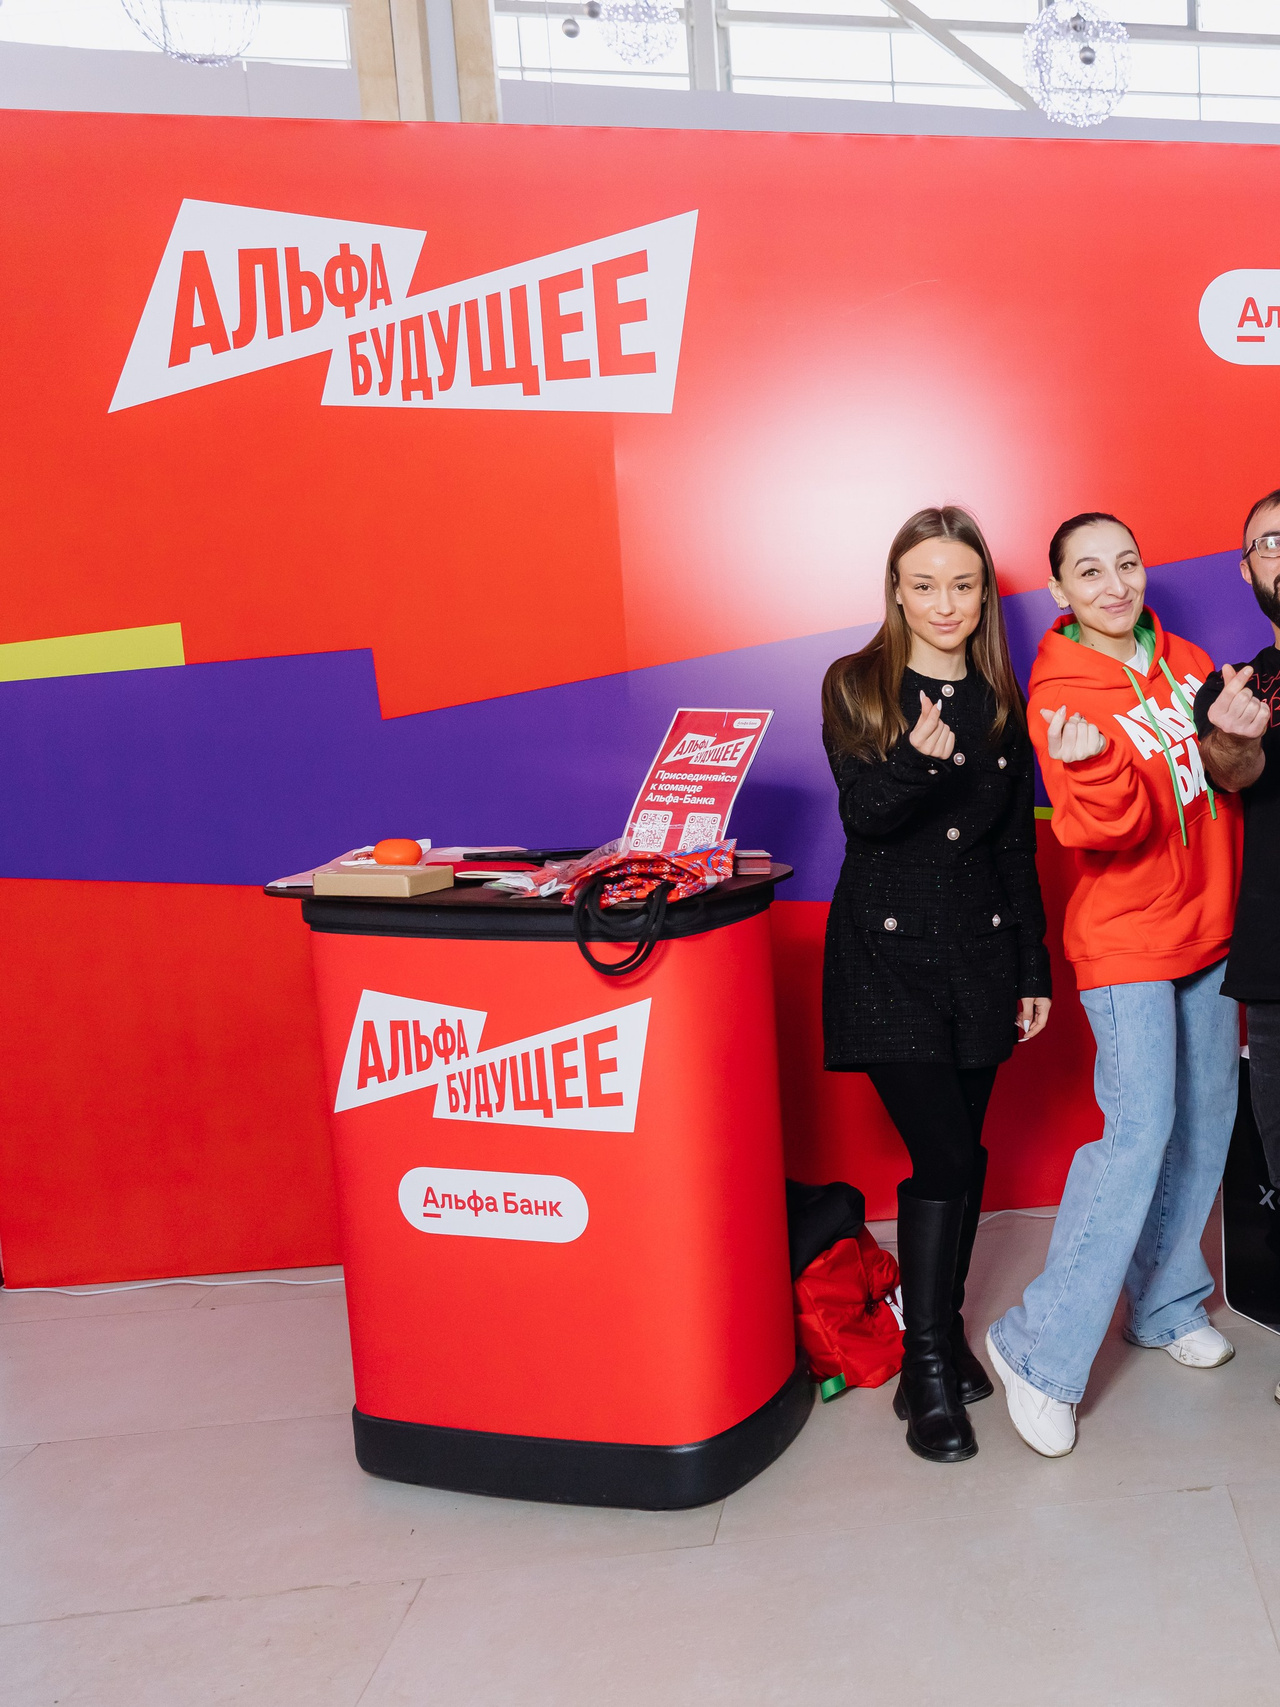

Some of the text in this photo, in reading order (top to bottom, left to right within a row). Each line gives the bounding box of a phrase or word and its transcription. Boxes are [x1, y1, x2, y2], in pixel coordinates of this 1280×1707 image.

[167, 242, 393, 368] АЛЬФА
[347, 250, 658, 402] БУДУЩЕЕ
[673, 739, 709, 757] АЛЬФА
[694, 741, 745, 763] БУДУЩЕЕ
[655, 770, 738, 783] Присоединяйся
[658, 784, 703, 793] команде
[645, 792, 716, 805] Альфа-Банка
[356, 1018, 471, 1090] АЛЬФА
[447, 1025, 625, 1119] БУДУЩЕЕ
[422, 1186, 563, 1218] Альфа Банк
